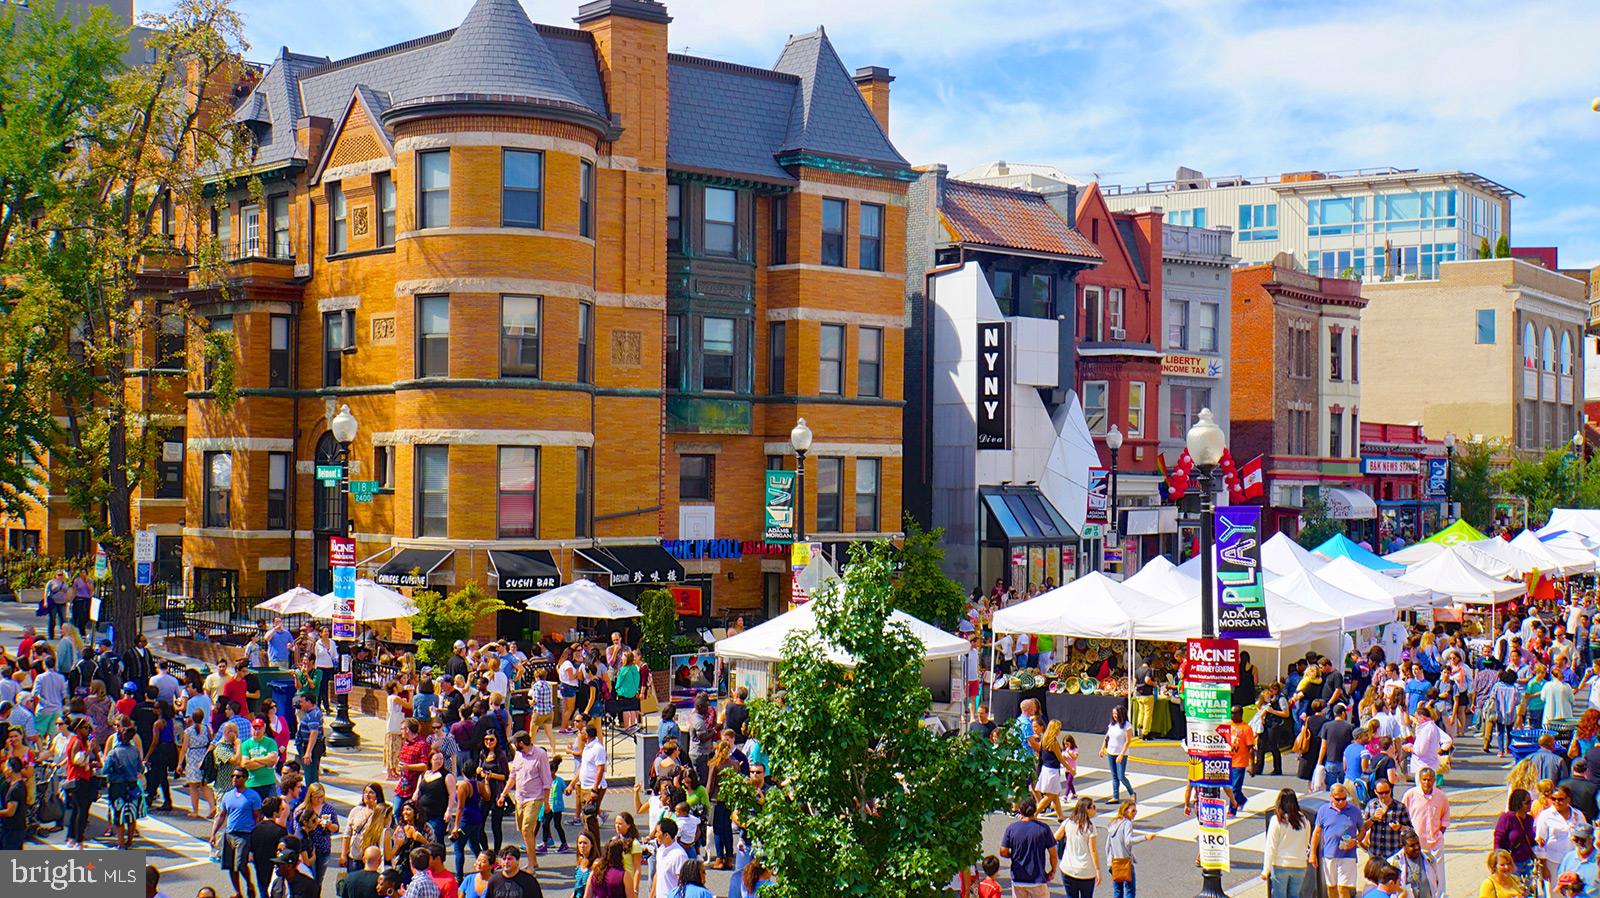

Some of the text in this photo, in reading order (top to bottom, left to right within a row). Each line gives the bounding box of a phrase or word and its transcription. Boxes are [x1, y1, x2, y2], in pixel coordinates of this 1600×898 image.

[1165, 355, 1201, 366] LIBERTY
[984, 328, 999, 420] NYNY
[1161, 364, 1206, 374] INCOME TAX
[979, 433, 1003, 444] Diva
[1383, 461, 1398, 471] NEWS
[1400, 461, 1416, 471] STAND
[318, 467, 337, 478] Belmont
[357, 482, 367, 492] 18
[355, 494, 372, 502] 2400
[767, 475, 794, 528] LIVE
[661, 540, 694, 560] WOK
[710, 539, 742, 559] ROLL
[743, 541, 767, 554] ASIAN
[769, 544, 791, 555] BISTR
[1219, 515, 1259, 604] PLAY
[378, 574, 426, 585] CHINESE CUISINE
[505, 577, 555, 588] SUSHI BAR
[1222, 610, 1261, 619] ADAMS
[1219, 618, 1266, 628] MORGAN
[1189, 649, 1236, 662] RACINE
[1215, 665, 1236, 673] GENERAL
[1186, 689, 1217, 699] EUGENE
[1186, 698, 1228, 709] PURYEAR
[1204, 760, 1230, 769] SCOTT
